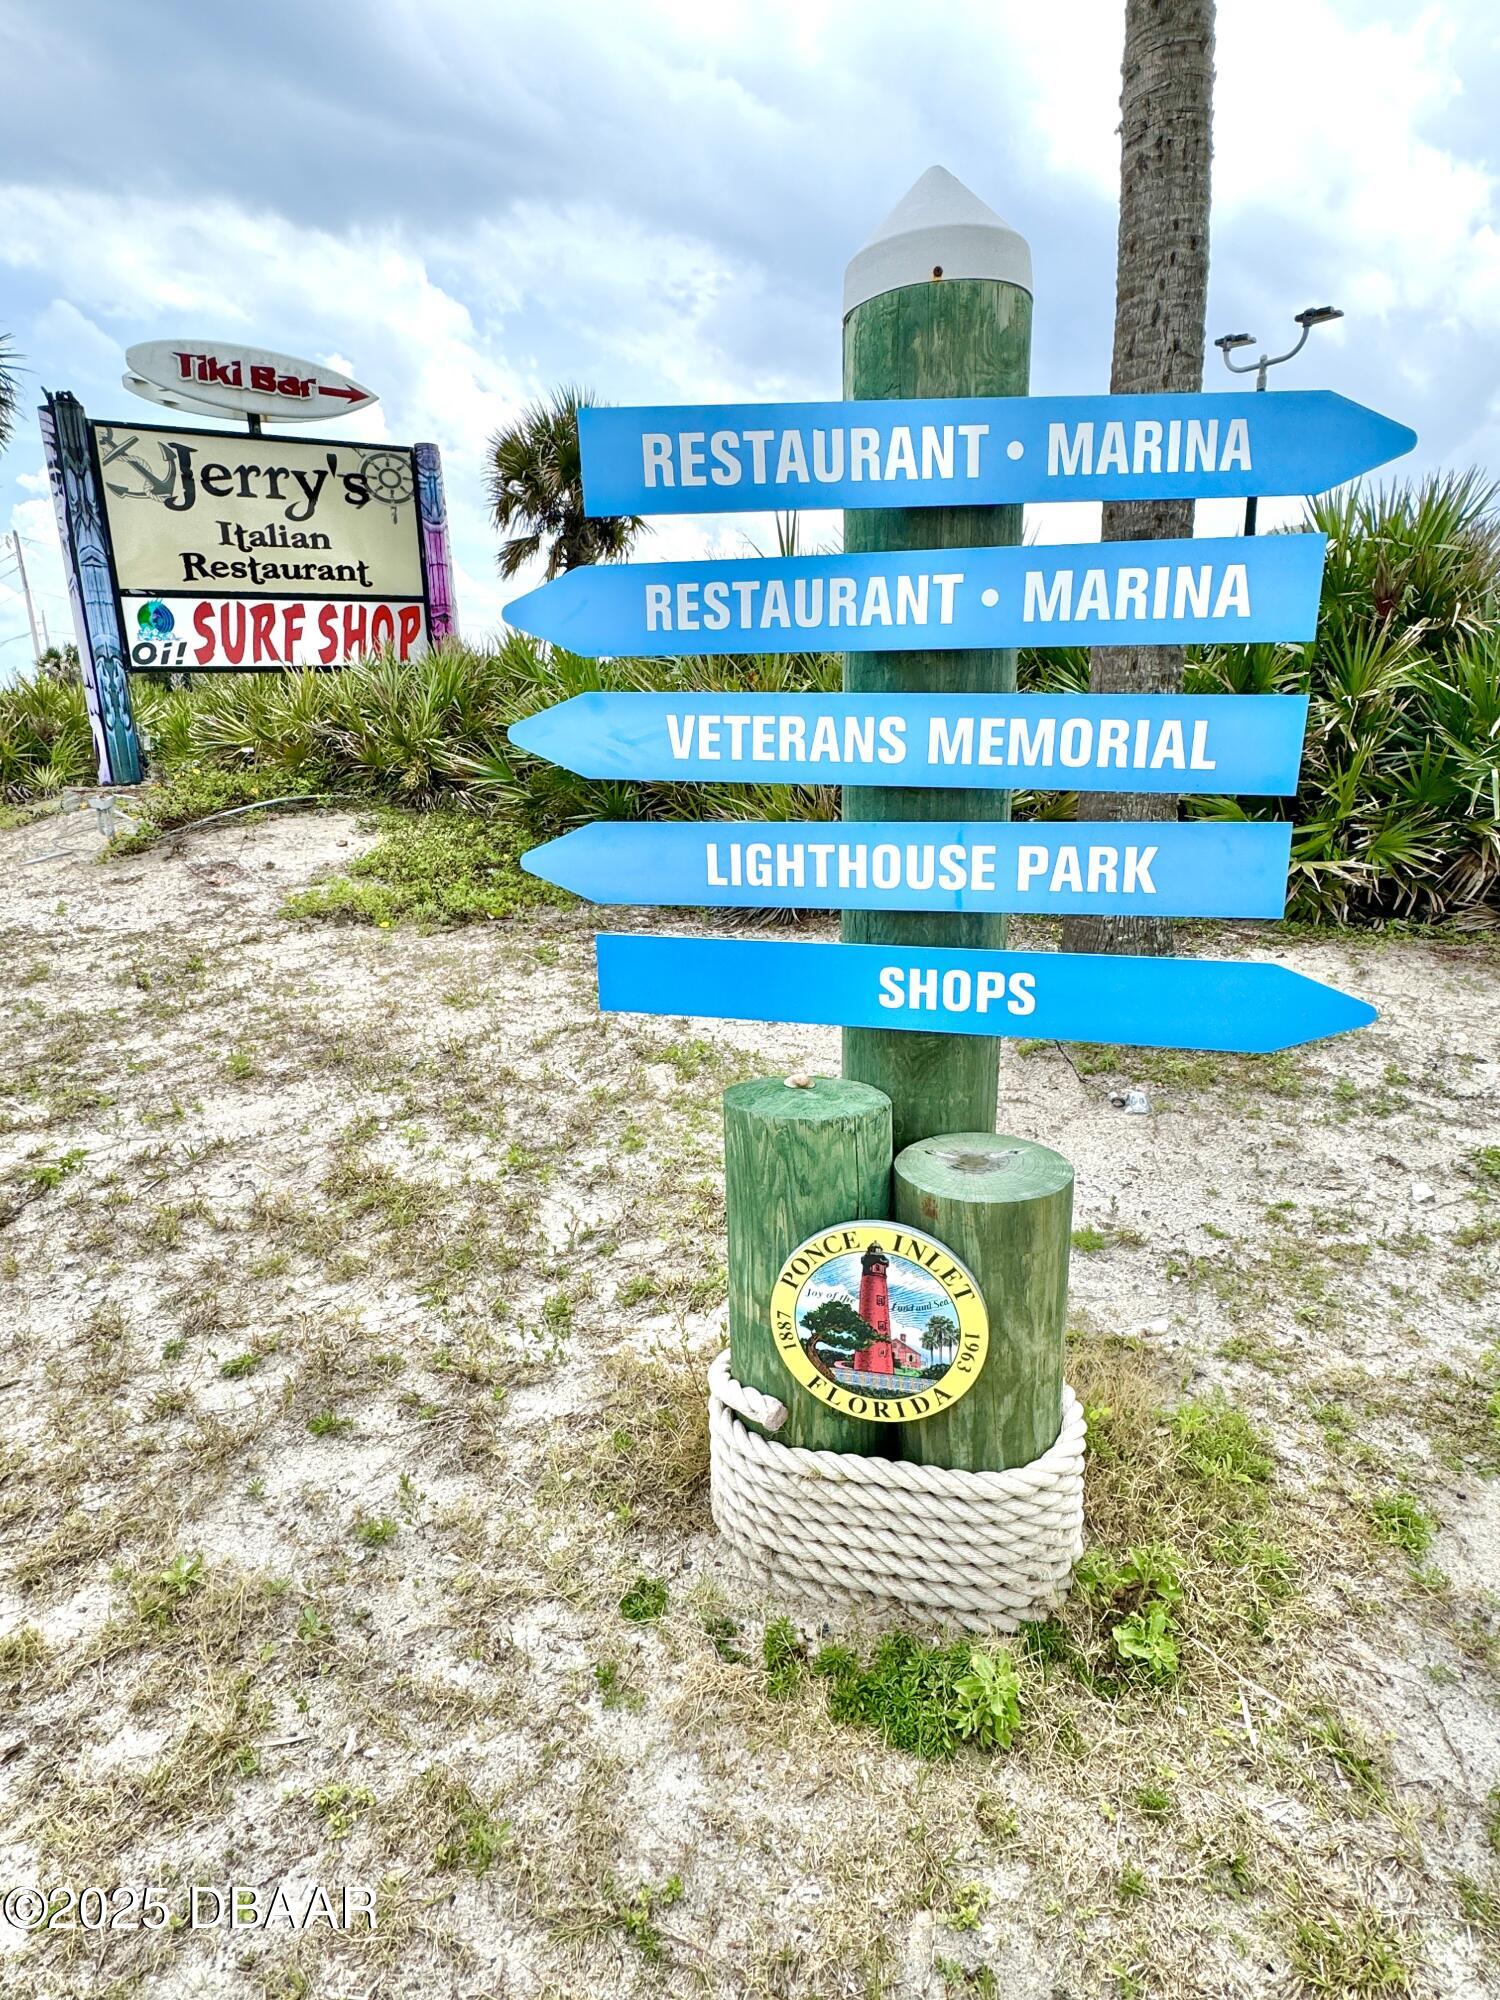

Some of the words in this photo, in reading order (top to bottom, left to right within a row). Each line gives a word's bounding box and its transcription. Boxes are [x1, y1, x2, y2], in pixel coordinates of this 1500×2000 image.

[172, 351, 242, 388] Tiki
[250, 365, 317, 398] Bar
[642, 423, 990, 489] RESTAURANT
[1047, 418, 1253, 477] MARINA
[163, 441, 372, 522] Jerry's
[215, 520, 332, 552] Italian
[179, 552, 374, 588] Restaurant
[645, 573, 964, 632] RESTAURANT
[1022, 564, 1252, 624] MARINA
[131, 641, 188, 666] Oi!
[193, 600, 306, 665] SURF
[317, 602, 421, 665] SHOP
[666, 713, 908, 765] VETERANS
[927, 716, 1217, 772] MEMORIAL
[705, 842, 996, 892] LIGHTHOUSE
[1016, 845, 1159, 896] PARK
[878, 965, 1037, 1017] SHOPS
[780, 1231, 860, 1290] PONCE
[892, 1234, 976, 1301] INLET
[826, 1291, 839, 1301] of
[776, 1310, 798, 1350] 1887
[956, 1332, 981, 1374] 1963
[806, 1374, 953, 1419] FLORIDA
